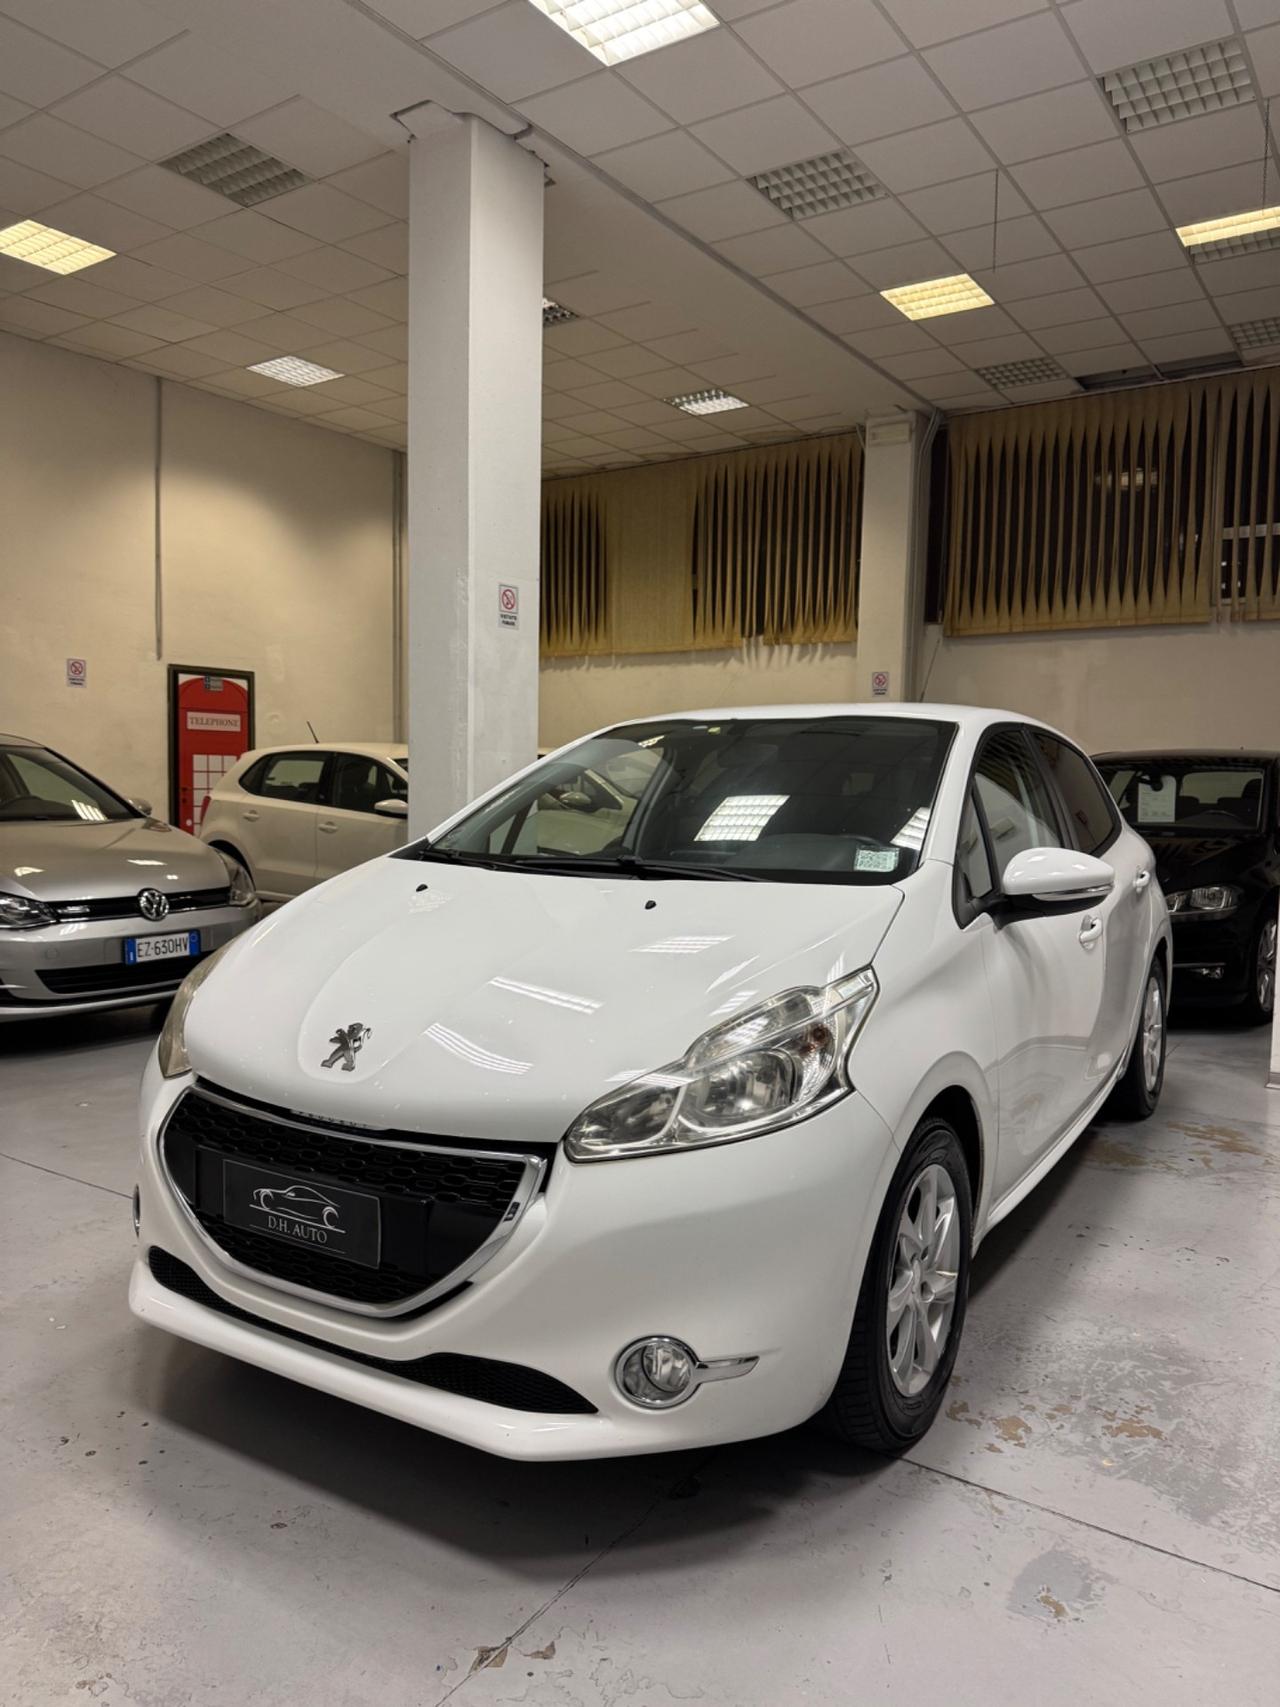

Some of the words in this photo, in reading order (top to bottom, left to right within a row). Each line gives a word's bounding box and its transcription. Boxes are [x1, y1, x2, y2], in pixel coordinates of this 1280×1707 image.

[189, 716, 239, 728] TELEPHONE
[268, 1215, 290, 1234] D.H.
[292, 1223, 328, 1244] AUTO
